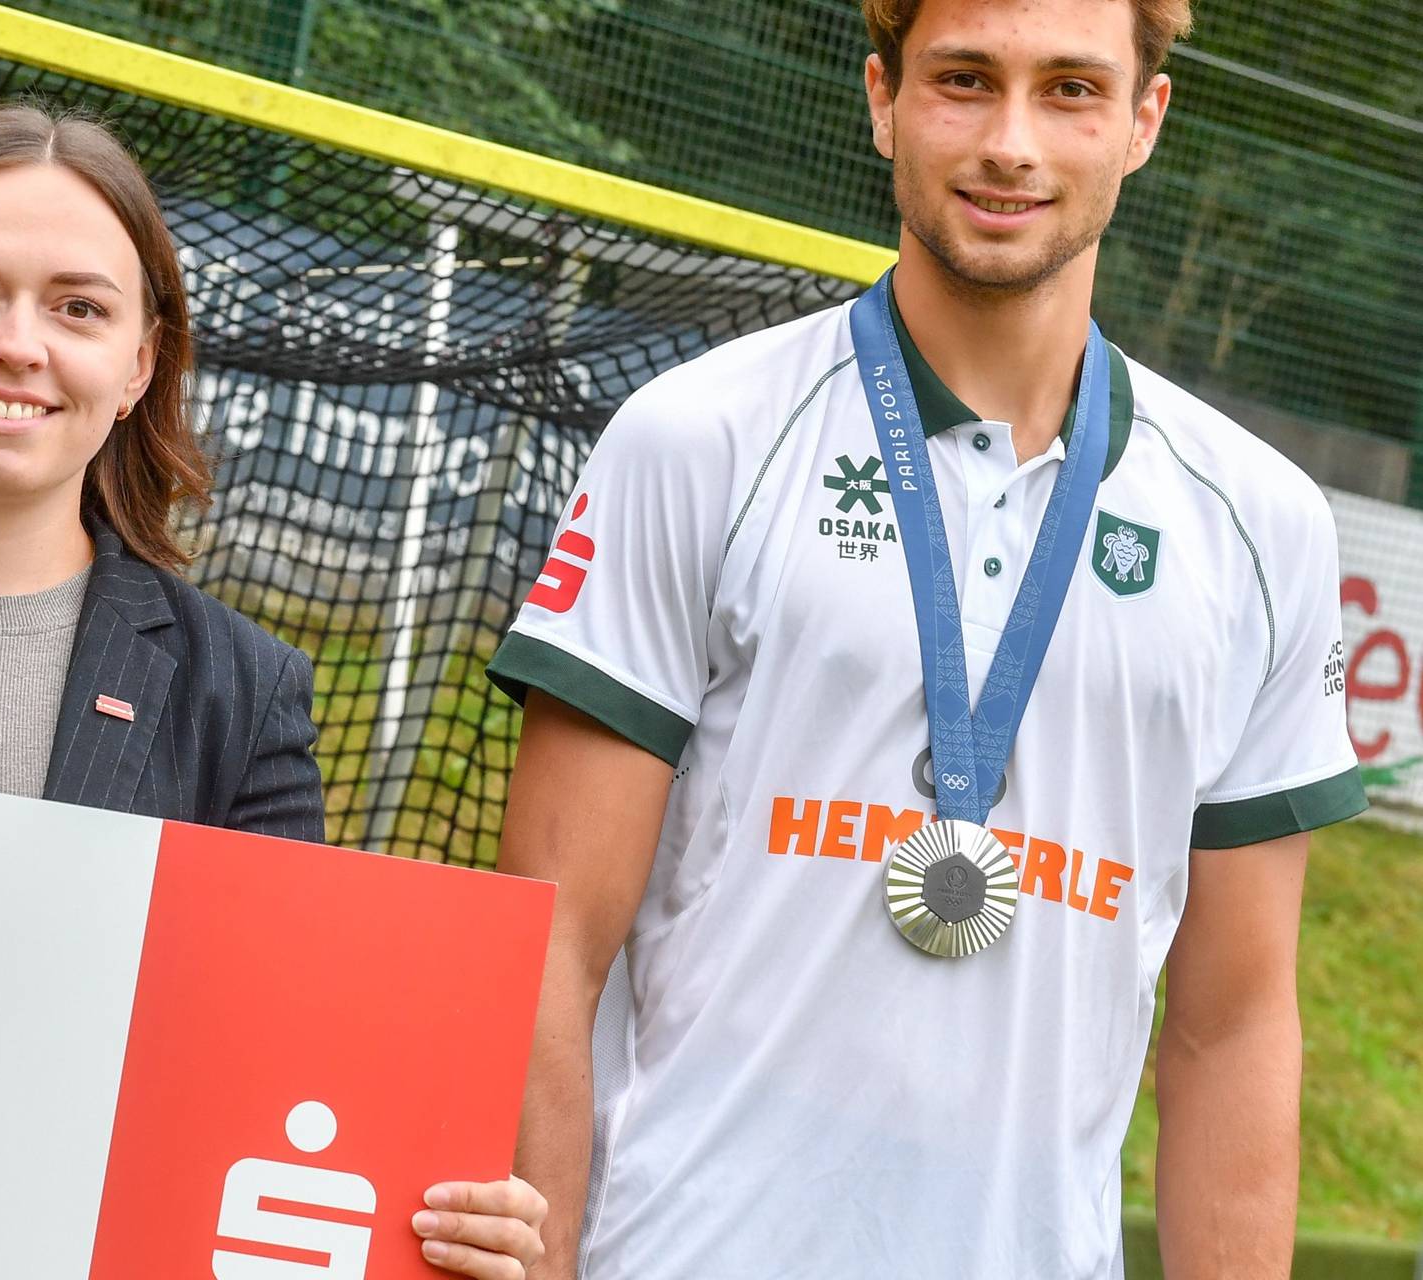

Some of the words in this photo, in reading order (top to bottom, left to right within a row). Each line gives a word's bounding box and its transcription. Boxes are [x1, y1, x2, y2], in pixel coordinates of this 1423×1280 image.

[873, 365, 902, 421] 2024
[845, 480, 873, 492] 大阪
[818, 517, 898, 543] OSAKA
[836, 541, 879, 562] 世界
[767, 796, 1135, 922] HEMRLE
